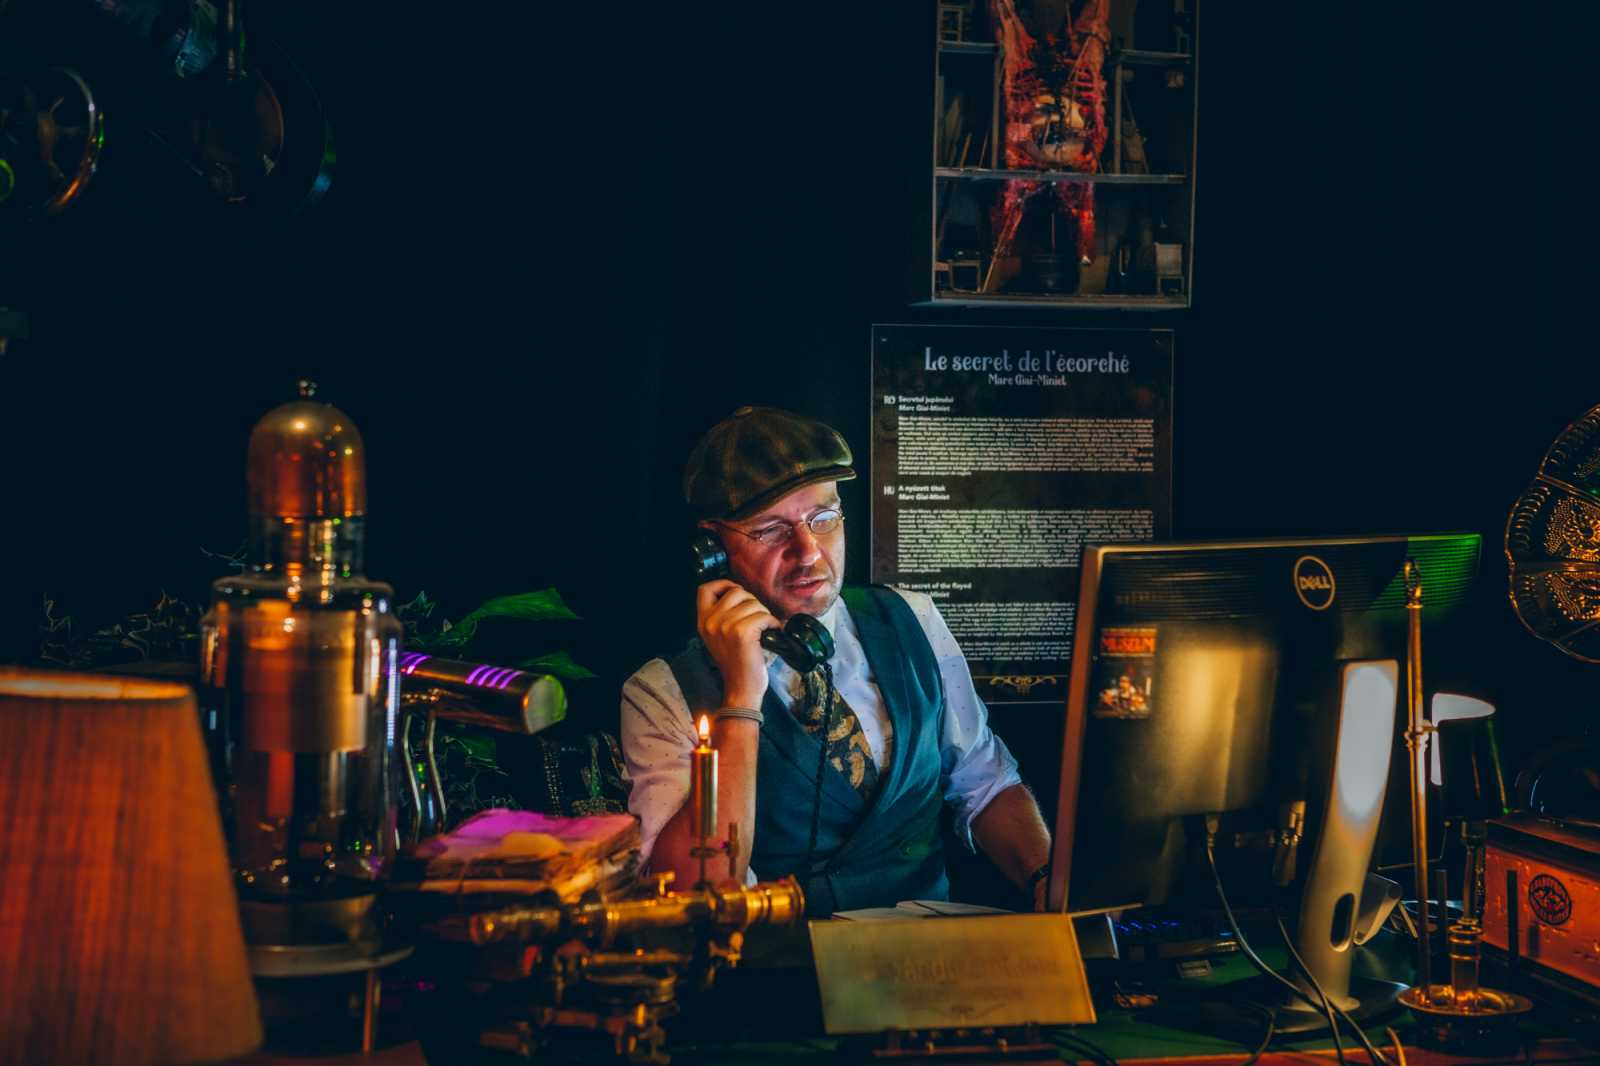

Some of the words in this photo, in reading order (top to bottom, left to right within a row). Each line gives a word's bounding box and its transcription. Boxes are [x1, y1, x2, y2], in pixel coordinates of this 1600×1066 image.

[925, 347, 948, 371] Le
[952, 350, 1013, 372] secret
[1018, 350, 1041, 372] de
[988, 373, 1013, 385] Marc
[884, 485, 895, 496] HU
[898, 582, 909, 590] The
[1299, 576, 1330, 590] DELL
